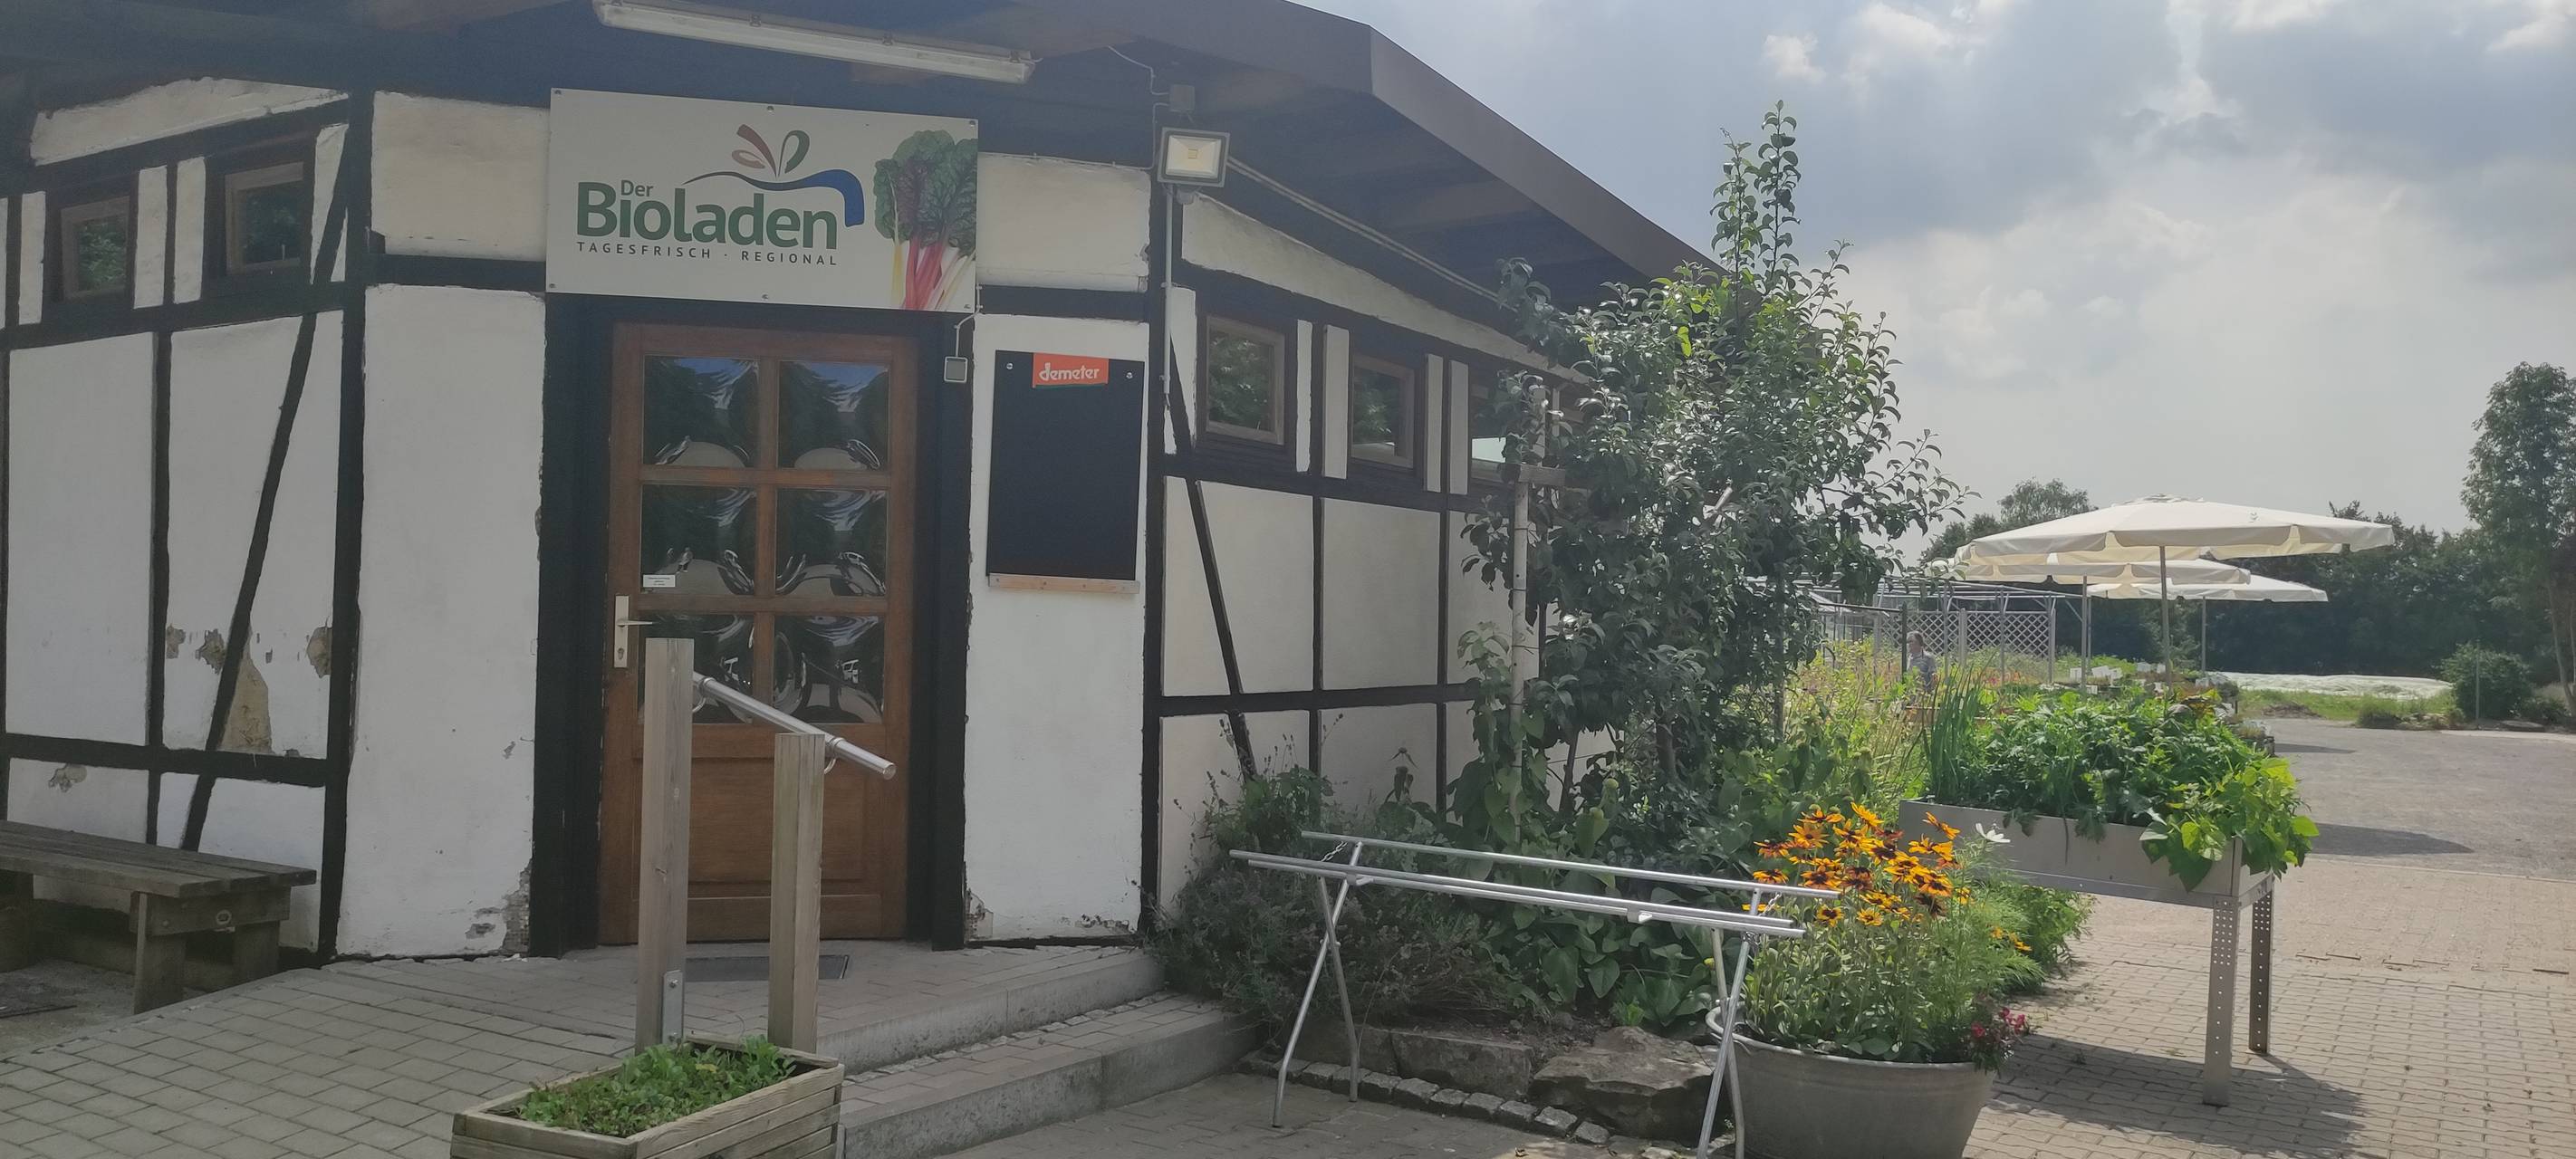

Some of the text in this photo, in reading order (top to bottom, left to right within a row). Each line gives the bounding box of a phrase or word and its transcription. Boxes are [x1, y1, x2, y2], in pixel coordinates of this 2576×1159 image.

[620, 179, 654, 197] Der
[577, 181, 838, 250] Bioladen
[577, 242, 837, 265] TAGESFRISCH REGIONAL
[1038, 362, 1100, 381] demeter
